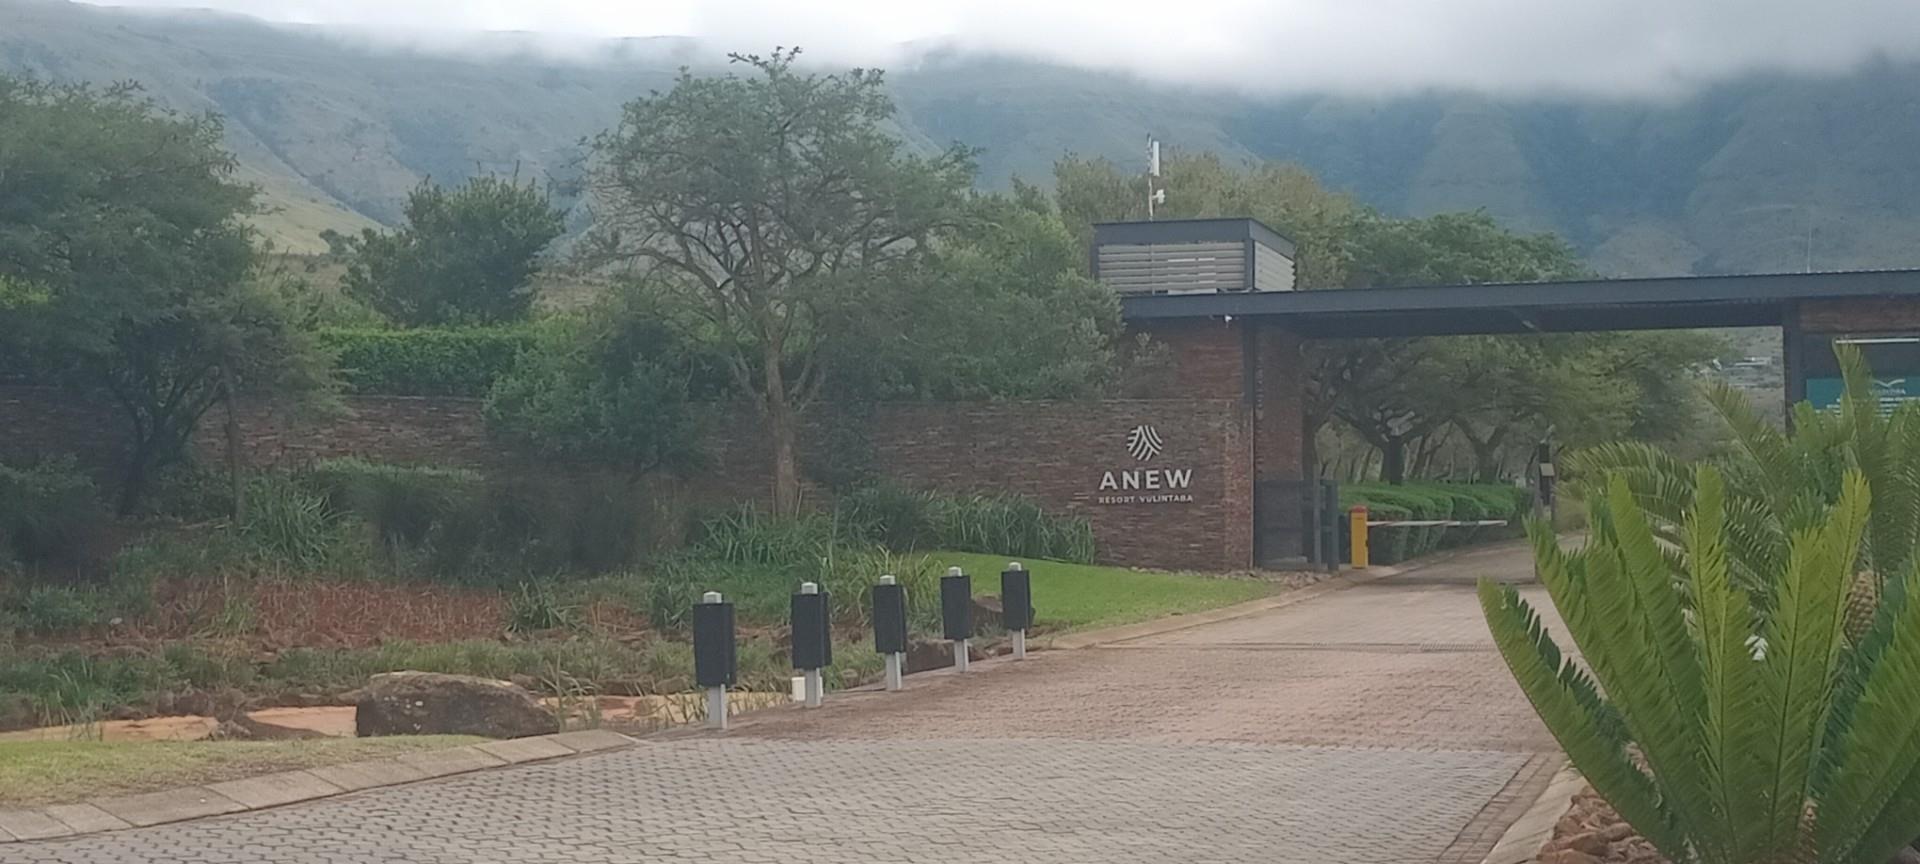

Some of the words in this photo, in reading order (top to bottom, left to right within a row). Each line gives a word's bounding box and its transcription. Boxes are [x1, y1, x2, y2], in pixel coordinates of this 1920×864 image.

[1099, 469, 1192, 490] ANEW
[1099, 496, 1135, 504] RESORT
[1139, 494, 1193, 503] VULINTABA
